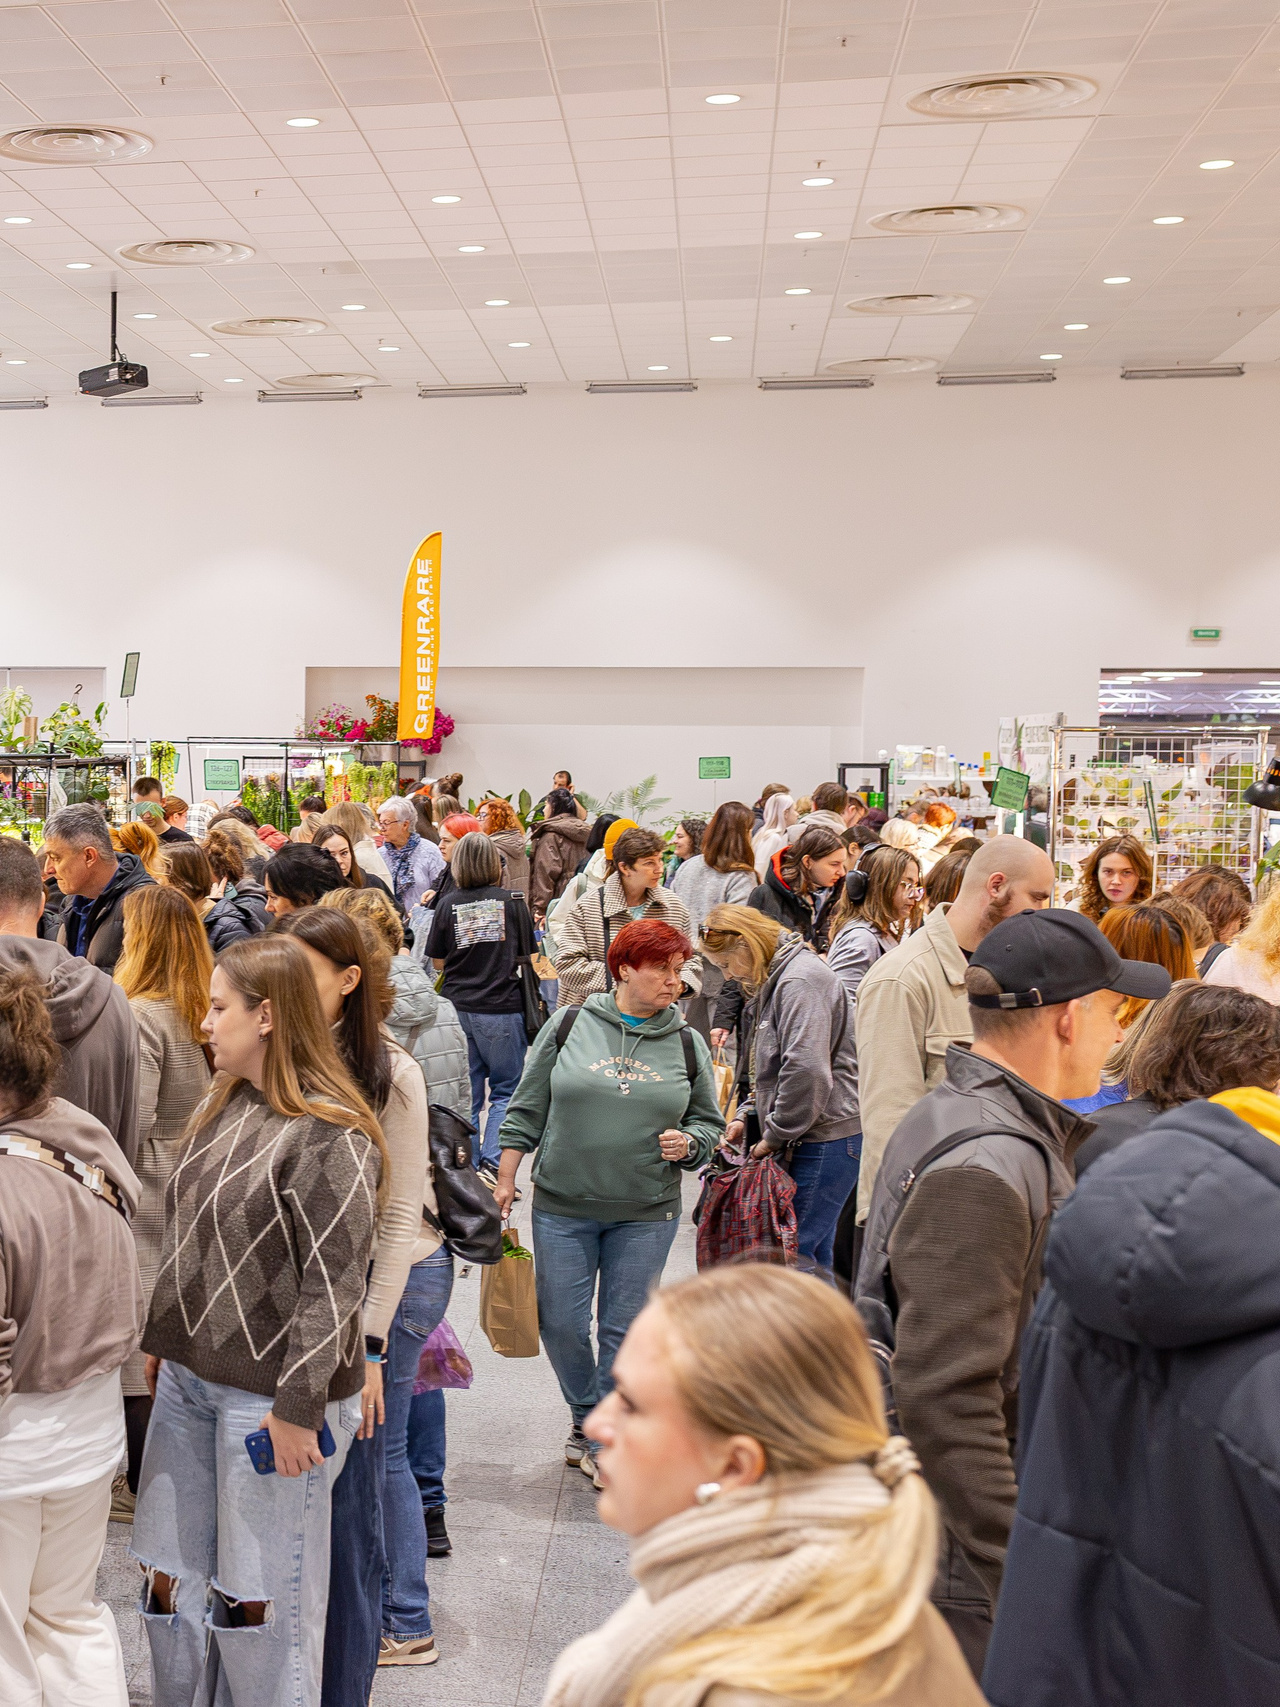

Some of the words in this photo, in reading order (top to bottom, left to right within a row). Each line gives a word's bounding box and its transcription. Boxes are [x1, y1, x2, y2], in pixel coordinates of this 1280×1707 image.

[414, 558, 431, 733] GREENRARE
[587, 1056, 651, 1072] MAJORED
[649, 1071, 664, 1082] IN
[604, 1068, 648, 1082] COOL
